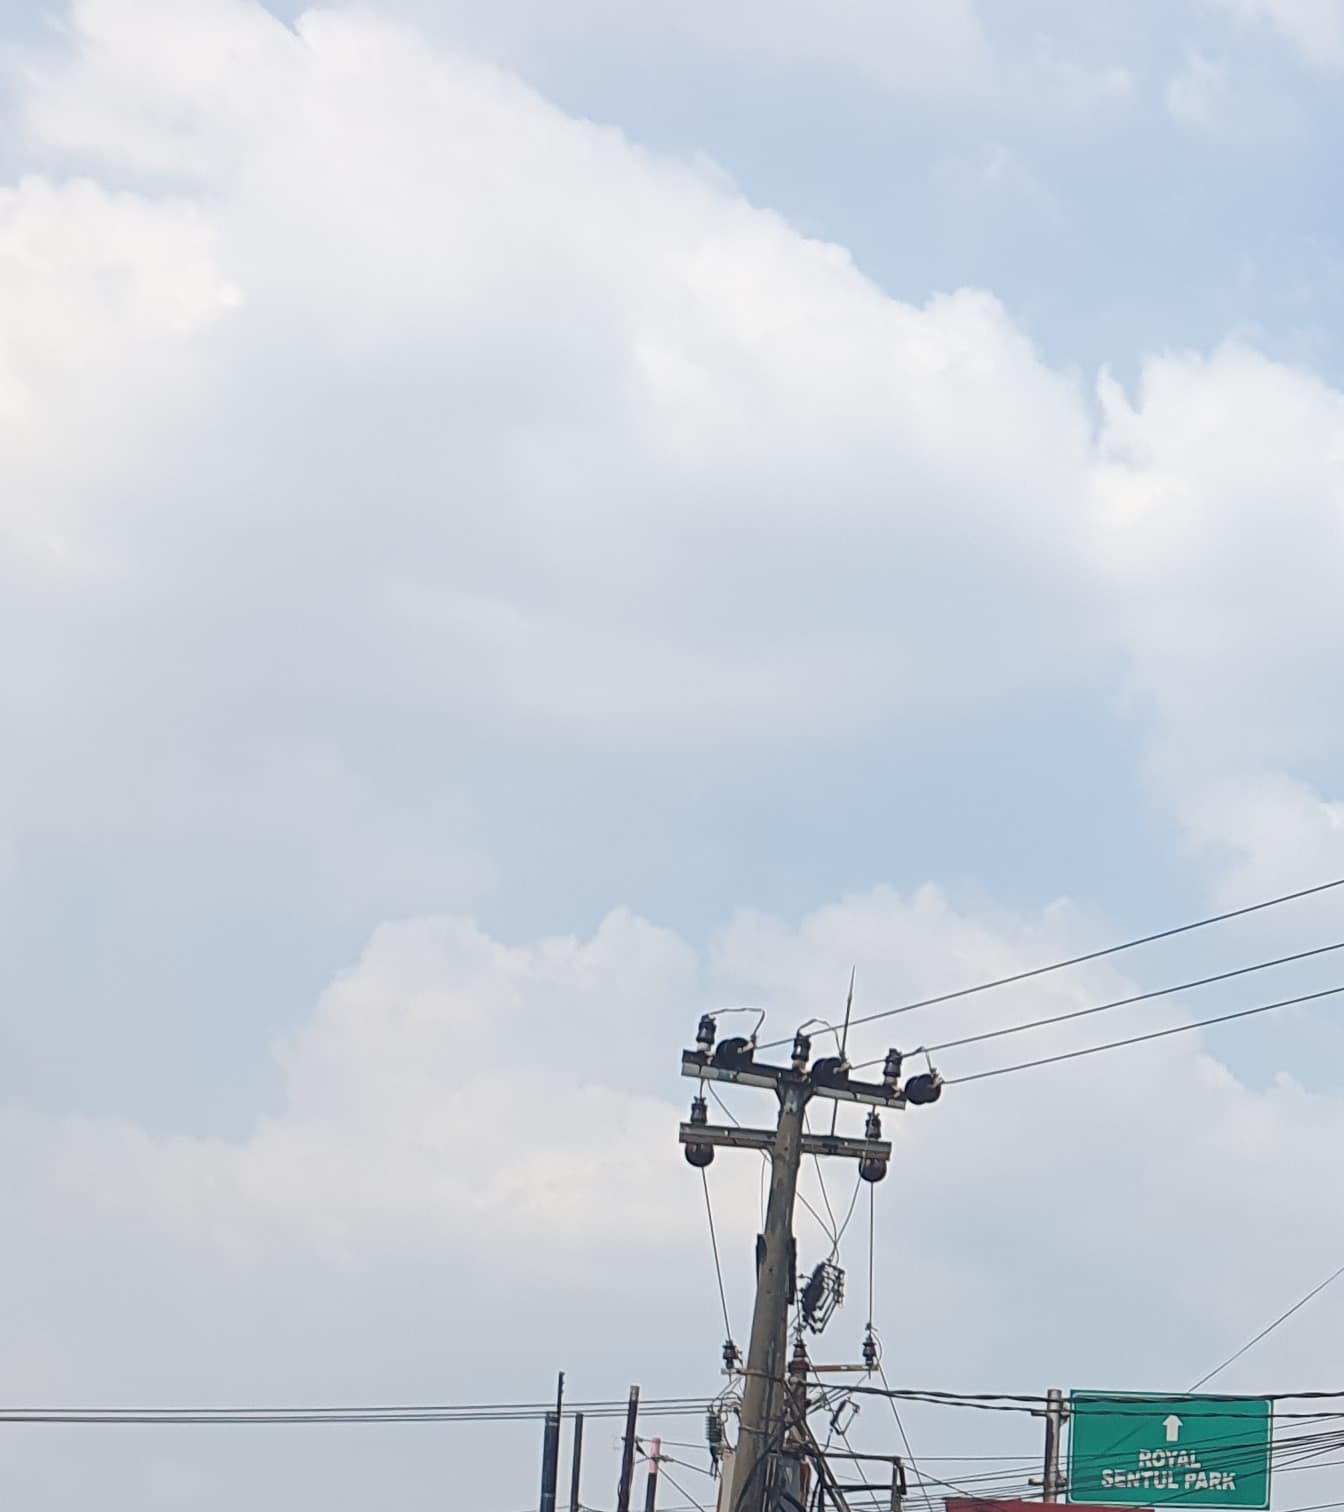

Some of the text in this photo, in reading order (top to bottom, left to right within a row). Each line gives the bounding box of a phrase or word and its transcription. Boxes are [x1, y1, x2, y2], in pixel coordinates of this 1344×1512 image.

[1139, 1449, 1201, 1469] ROYAL
[1101, 1469, 1236, 1490] SENTUL PARK
